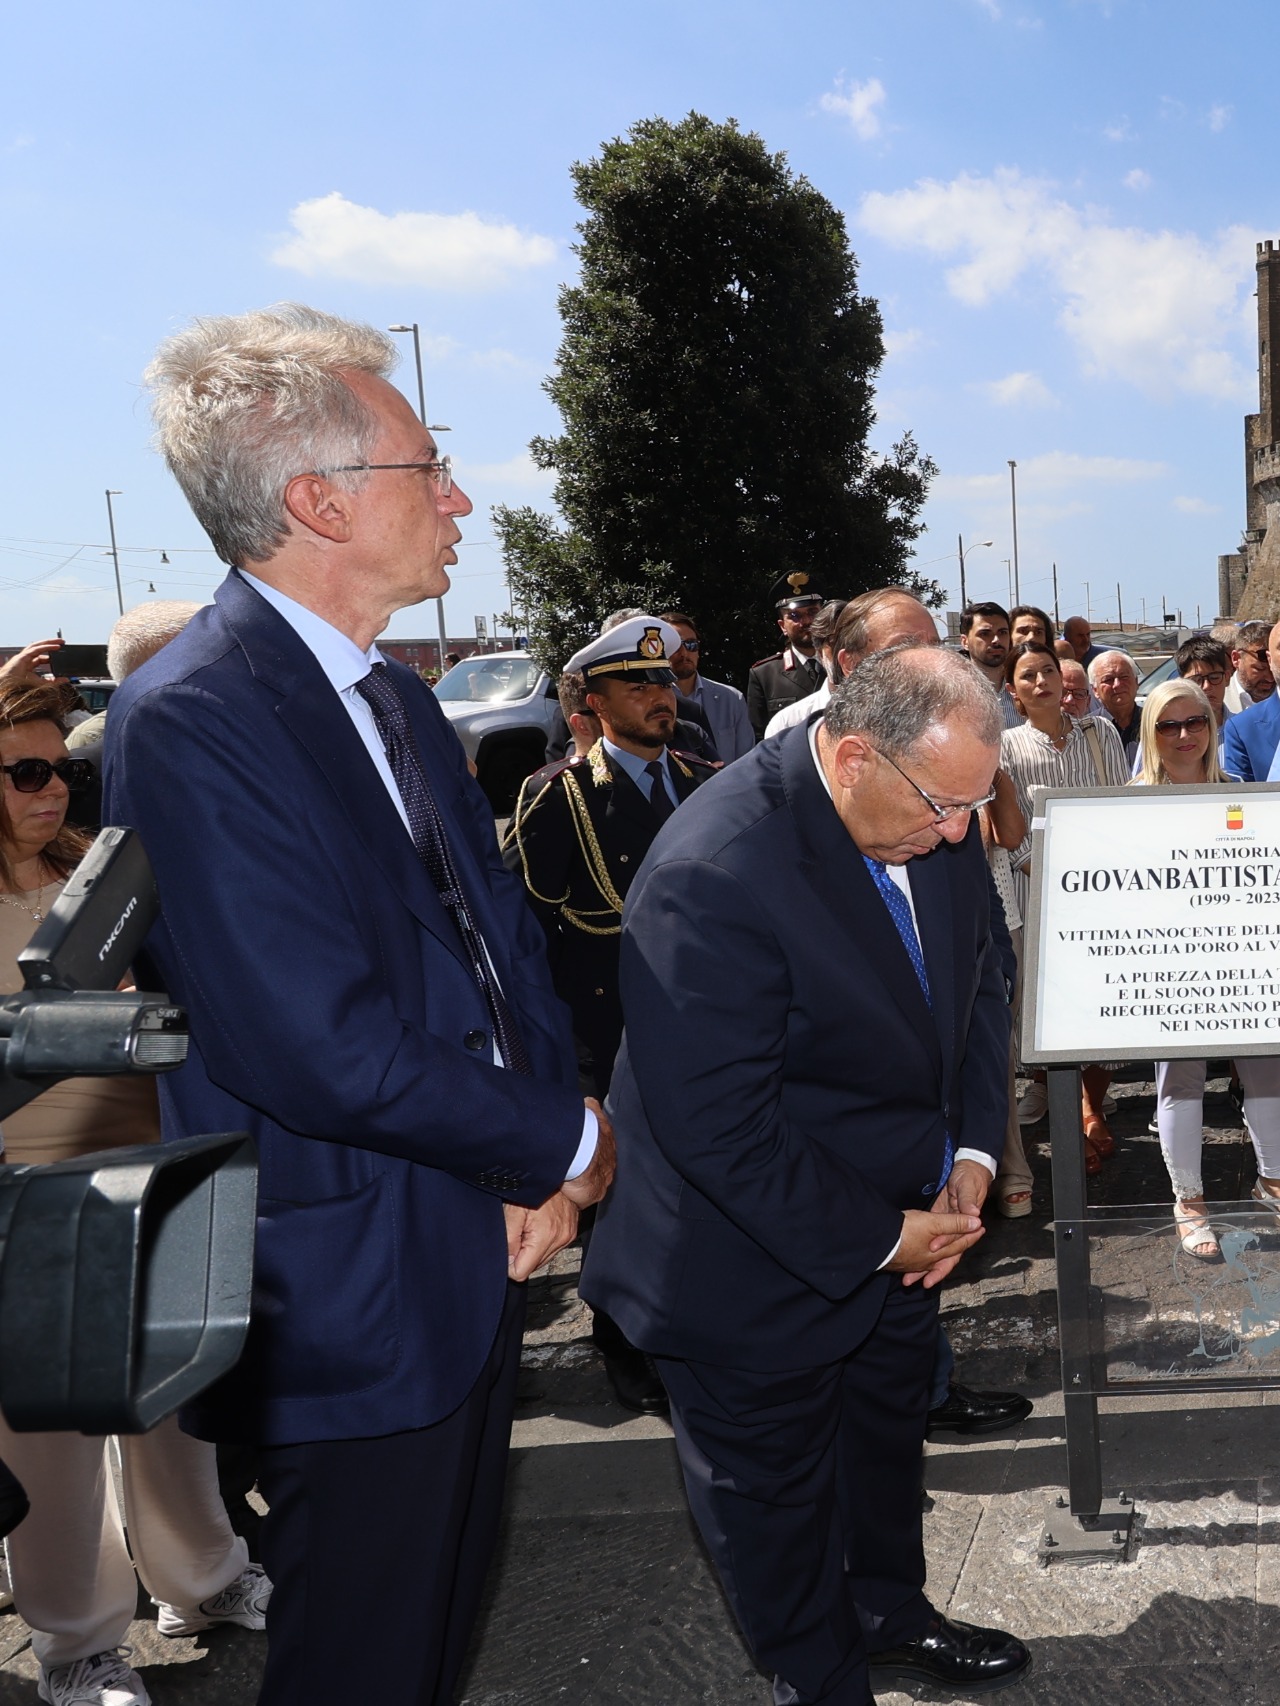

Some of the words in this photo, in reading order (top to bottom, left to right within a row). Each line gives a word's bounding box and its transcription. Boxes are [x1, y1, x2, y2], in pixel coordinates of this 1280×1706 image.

[1171, 849, 1188, 860] IN
[1189, 893, 1230, 909] (1999
[1058, 929, 1133, 941] VITTIMA
[1137, 925, 1237, 939] INNOCENTE
[1087, 942, 1182, 957] MEDAGLIA
[1185, 940, 1239, 954] D'ORO
[1243, 940, 1266, 952] AL
[1105, 973, 1128, 984] LA
[1132, 970, 1211, 983] PUREZZA
[1216, 968, 1272, 980] DELLA
[1119, 989, 1129, 1000] E
[1134, 988, 1152, 999] IL
[1155, 986, 1215, 999] SUONO
[1220, 984, 1254, 997] DEL
[1099, 1000, 1268, 1018] RIECHEGGERANNO
[1159, 1020, 1190, 1032] NEI
[1194, 1018, 1259, 1031] NOSTRI
